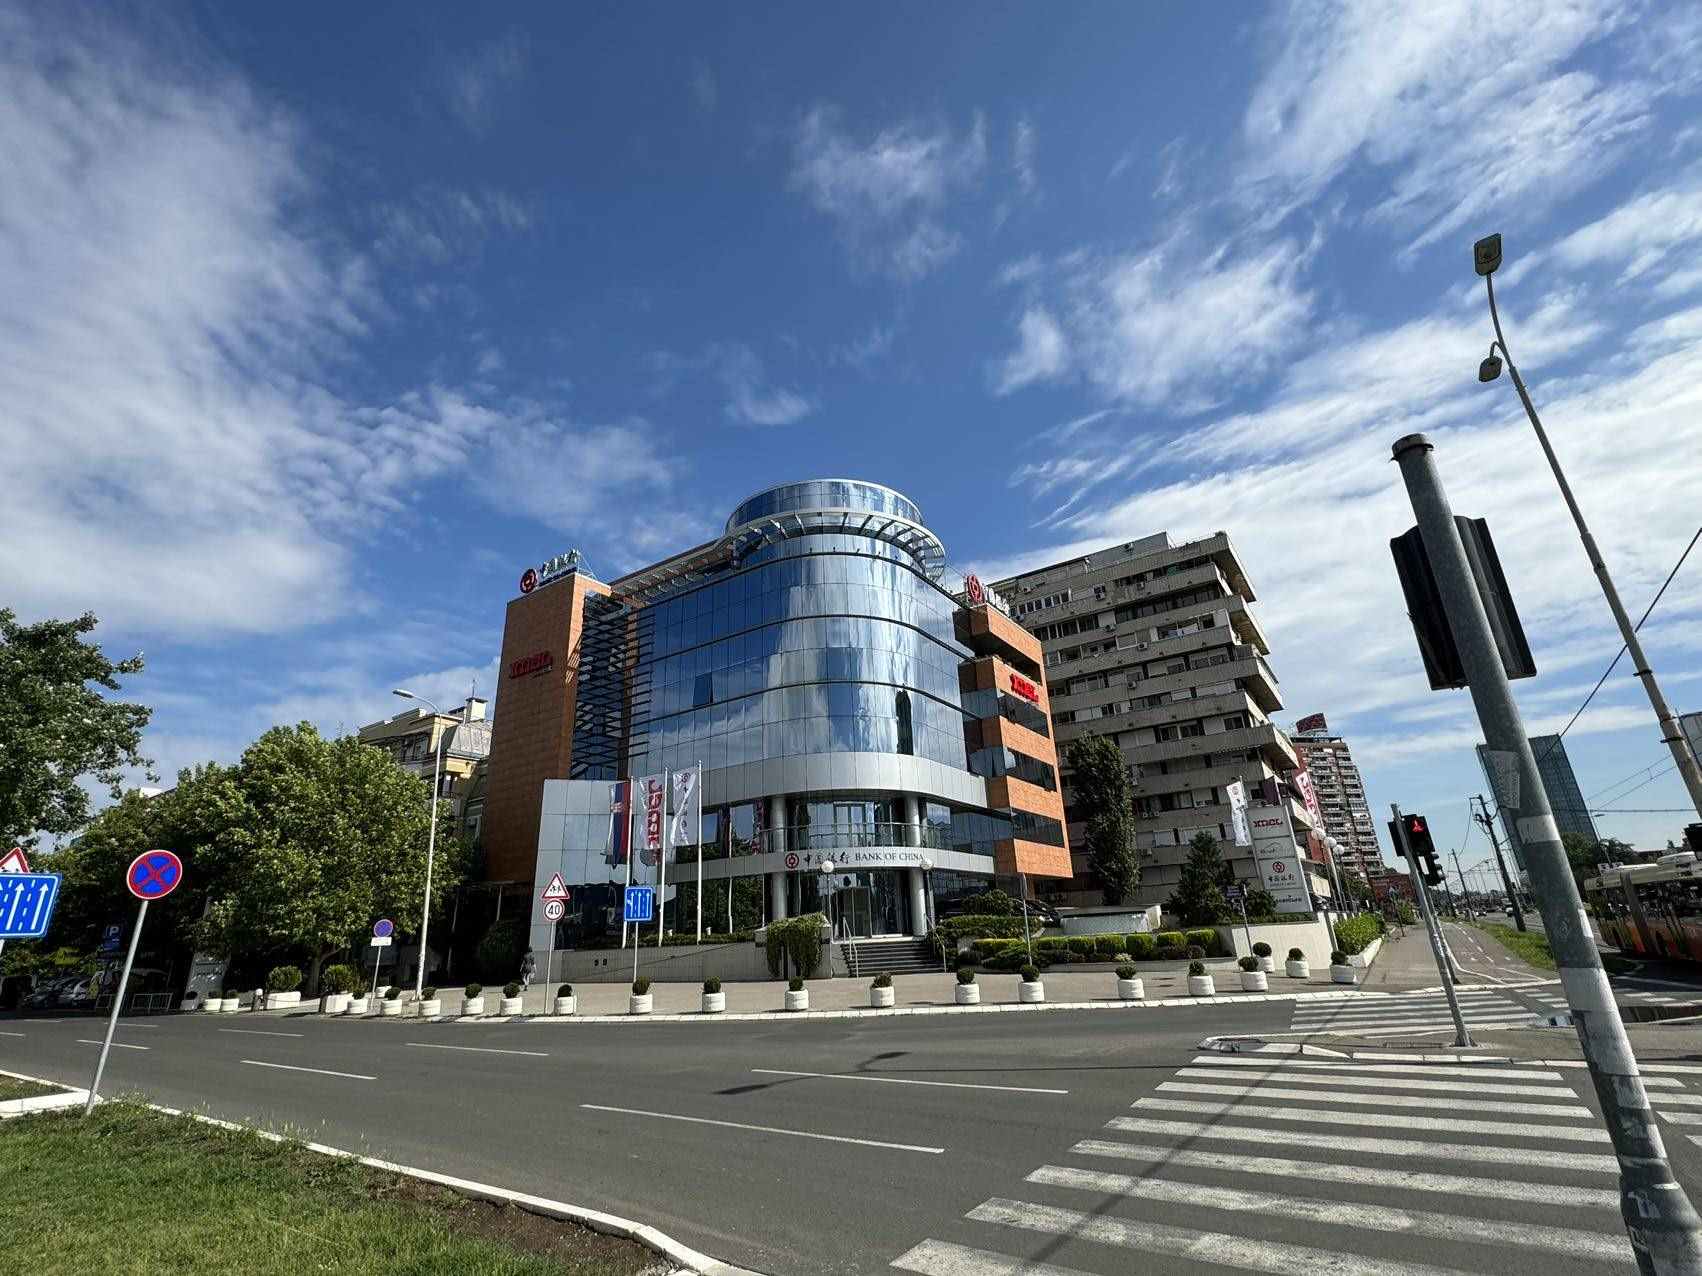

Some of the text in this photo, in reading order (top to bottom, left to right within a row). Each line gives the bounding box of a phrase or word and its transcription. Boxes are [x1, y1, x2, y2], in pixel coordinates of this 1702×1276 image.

[855, 852, 924, 861] BANK OF CHINA
[547, 904, 561, 916] 40
